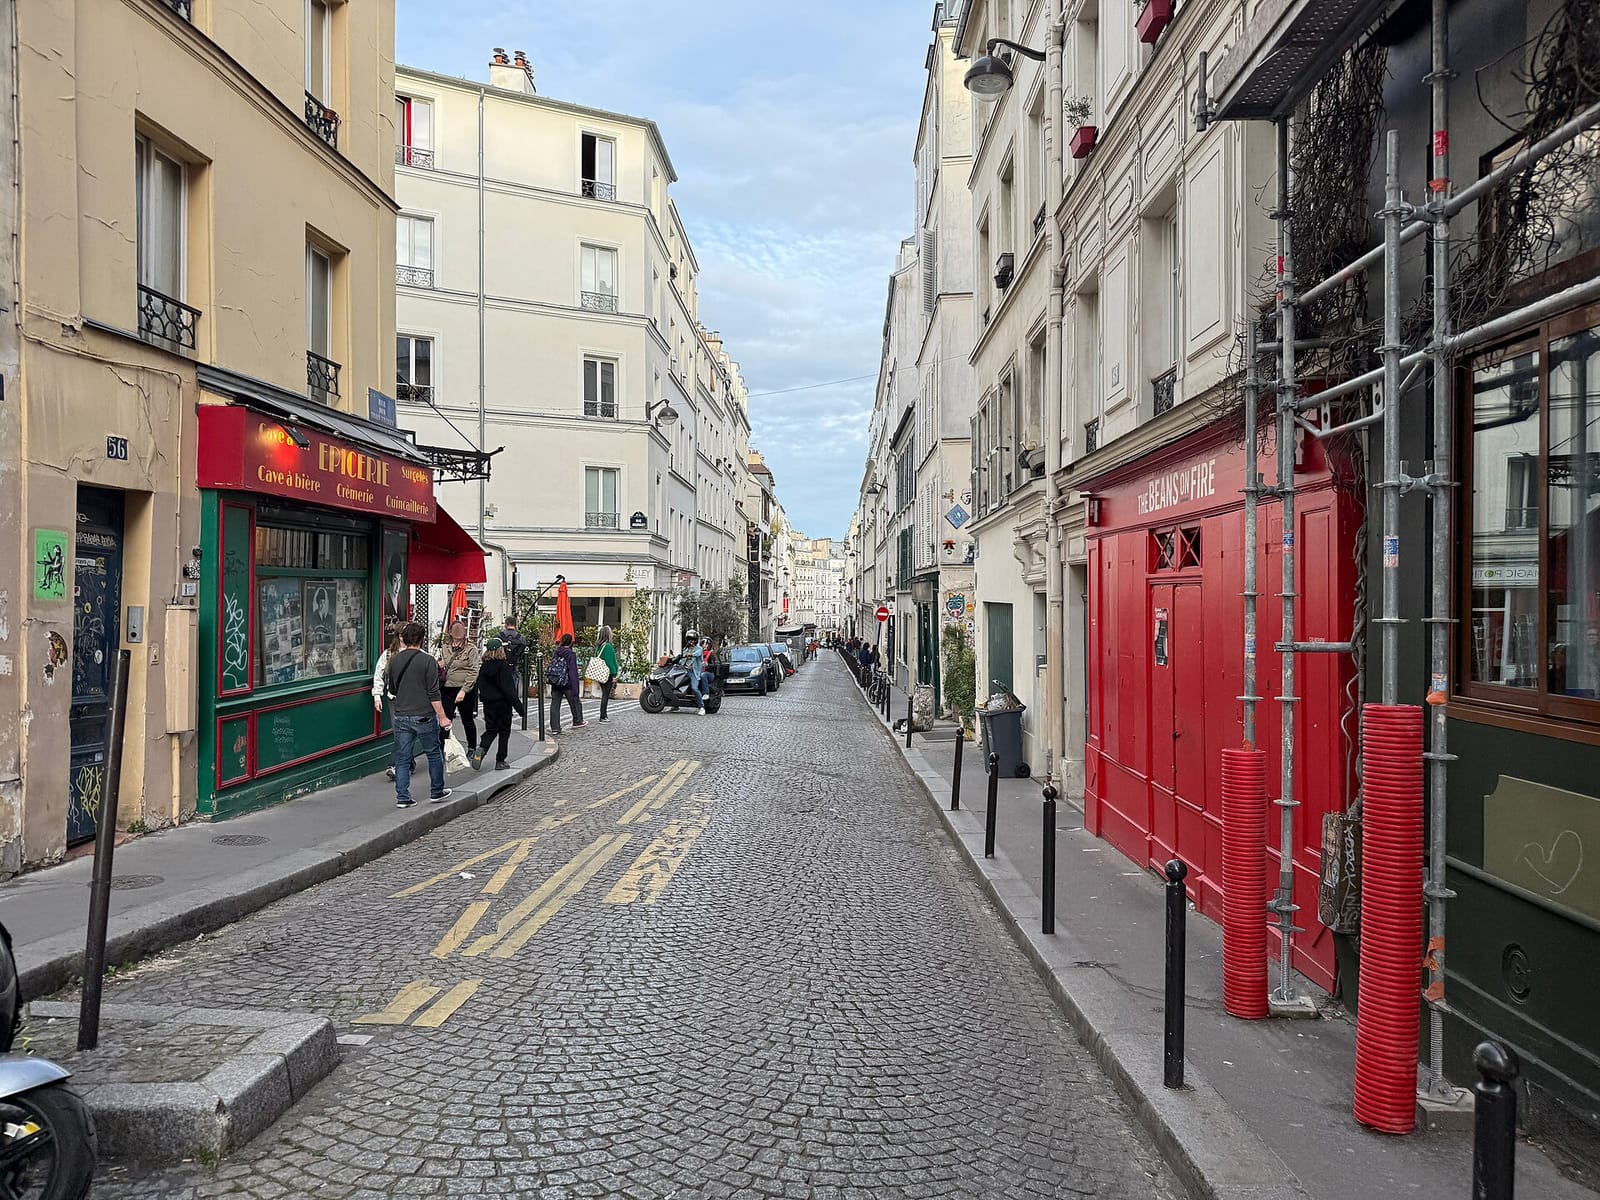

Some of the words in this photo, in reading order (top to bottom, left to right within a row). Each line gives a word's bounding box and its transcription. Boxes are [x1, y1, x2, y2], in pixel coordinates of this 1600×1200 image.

[258, 422, 285, 444] Cave
[108, 437, 125, 459] 56
[318, 441, 390, 487] EPICERIE
[257, 465, 285, 485] Cave
[286, 470, 293, 487] à
[295, 472, 321, 492] bière
[1138, 492, 1148, 515] THE
[1148, 472, 1179, 513] BEANS
[1180, 470, 1190, 496] ON
[1190, 459, 1216, 501] FIRE
[385, 494, 429, 516] Quincaillerie
